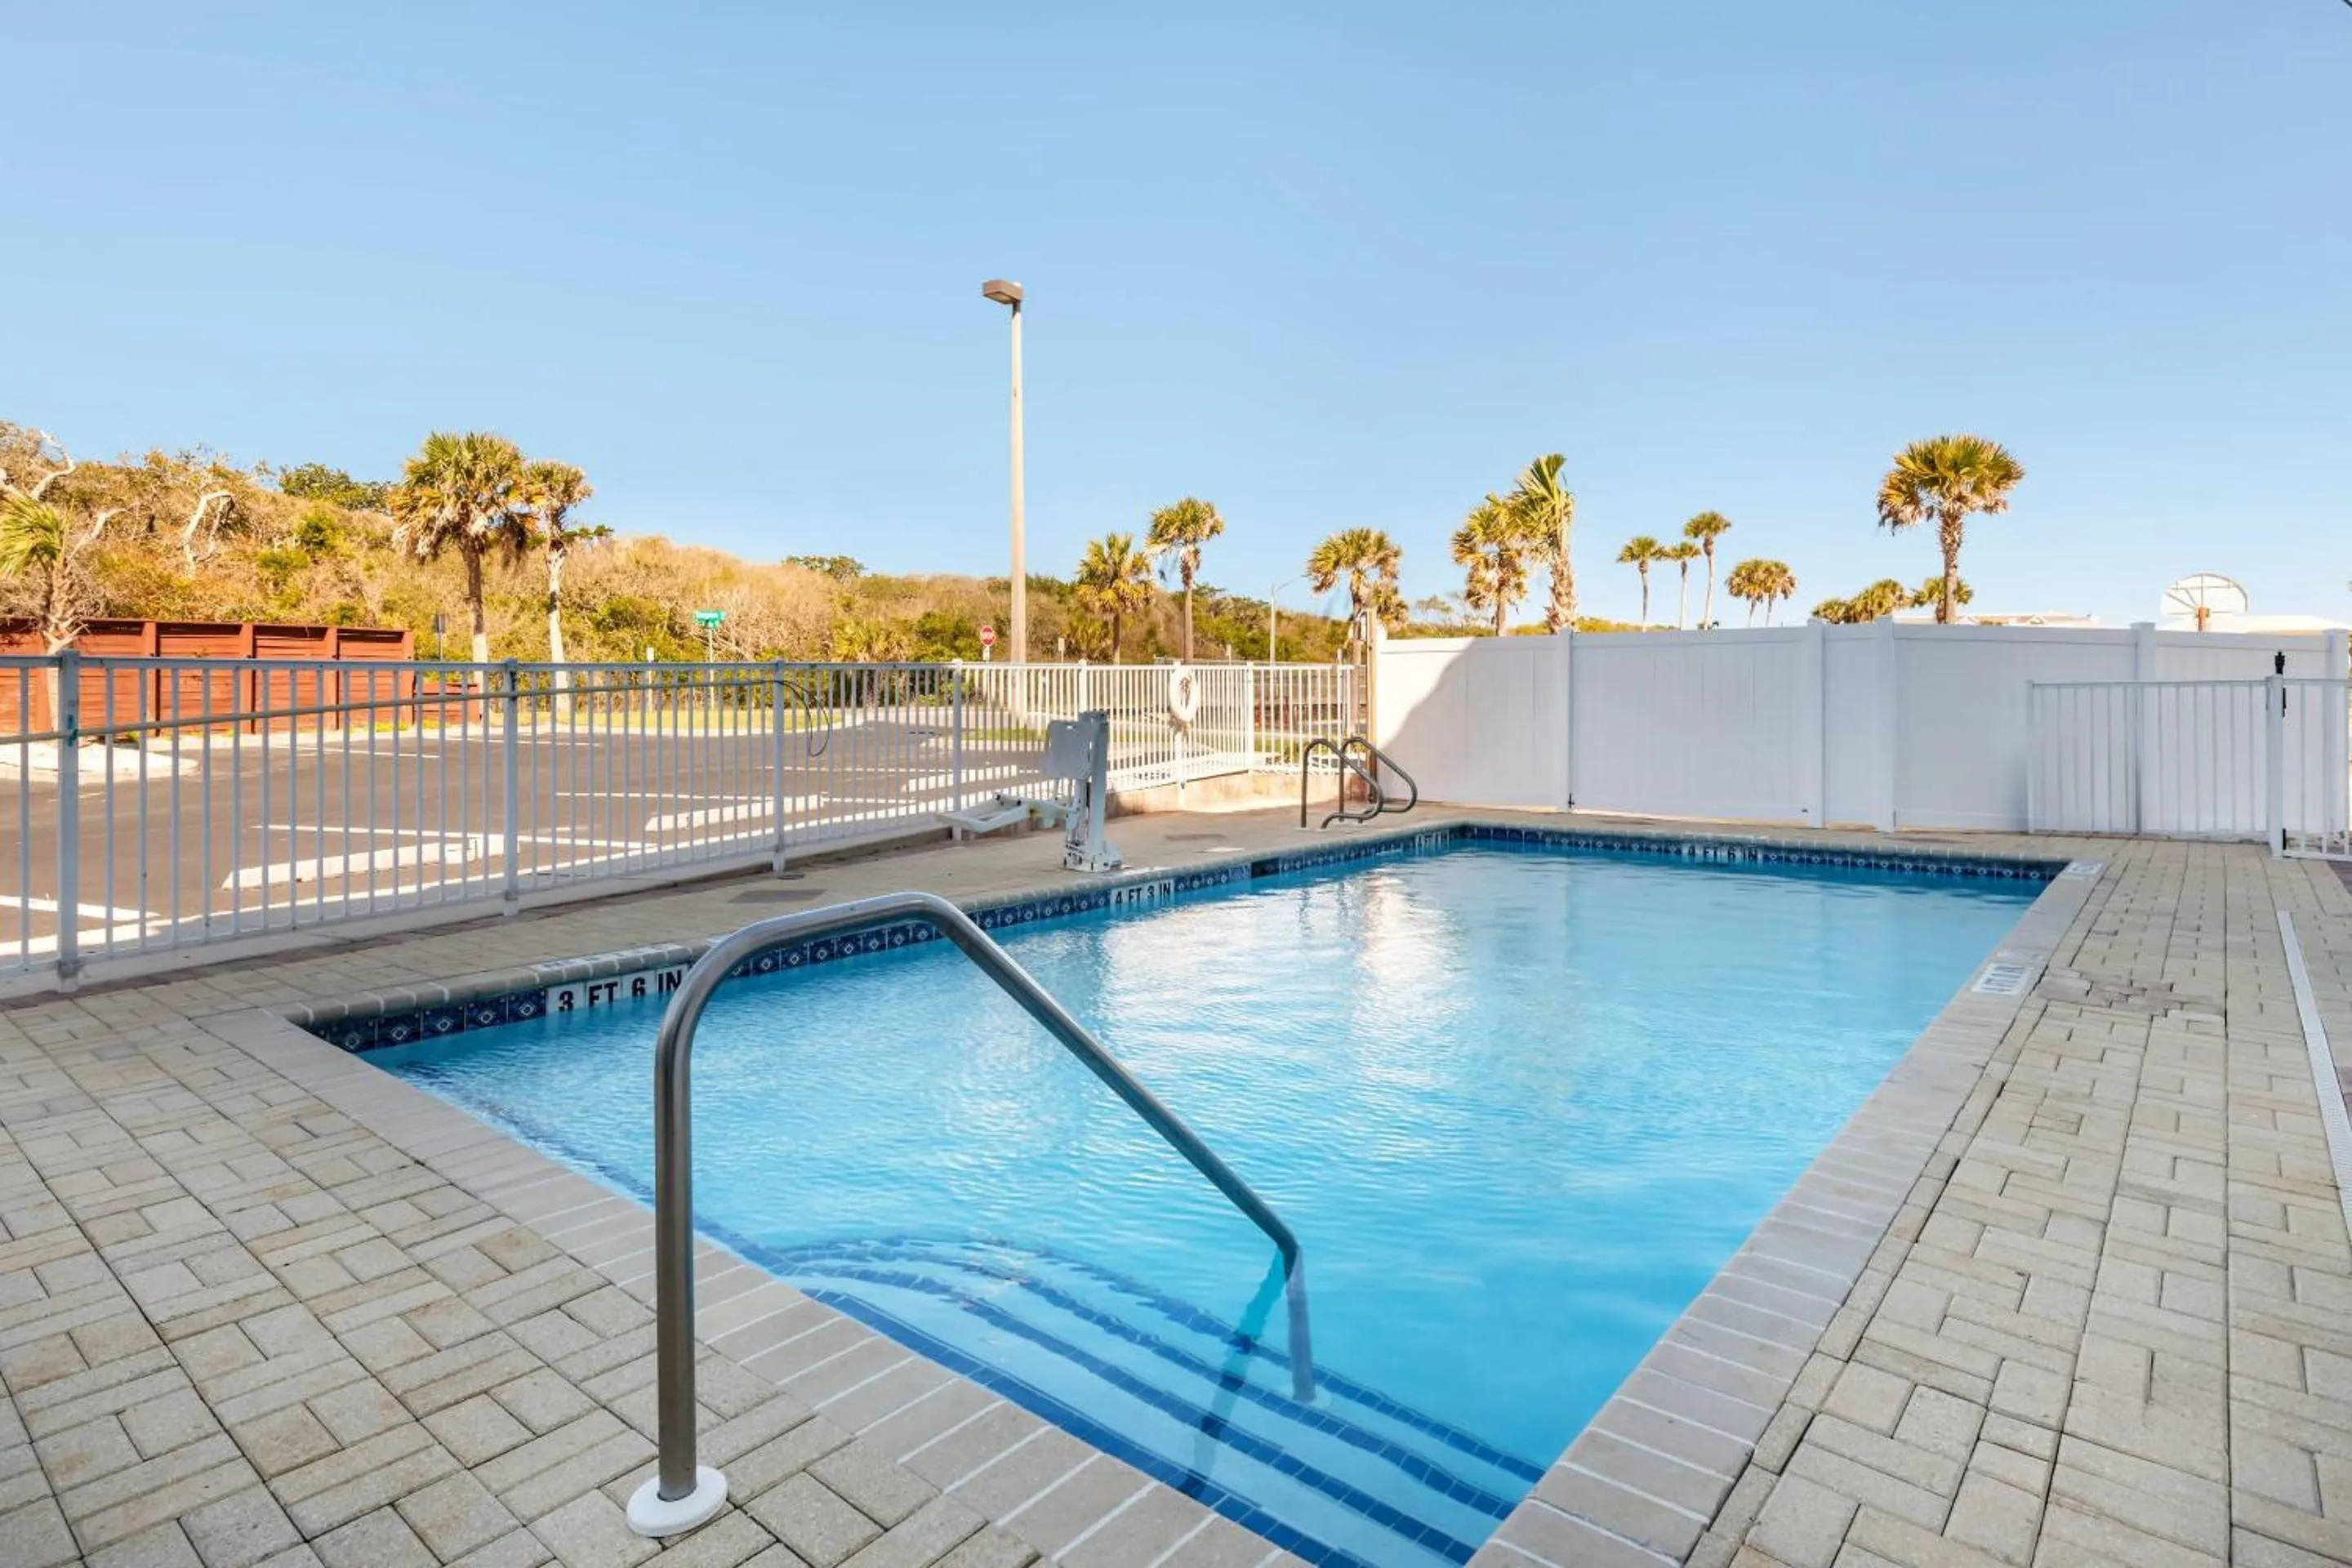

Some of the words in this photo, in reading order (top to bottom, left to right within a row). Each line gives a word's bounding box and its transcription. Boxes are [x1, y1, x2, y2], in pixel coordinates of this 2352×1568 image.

[1115, 890, 1123, 903] 4
[1128, 887, 1143, 902] FT
[1160, 882, 1171, 897] IN
[559, 990, 574, 1013] 3
[588, 982, 618, 1006] FT
[631, 977, 646, 998] 6
[657, 969, 682, 994] IN
